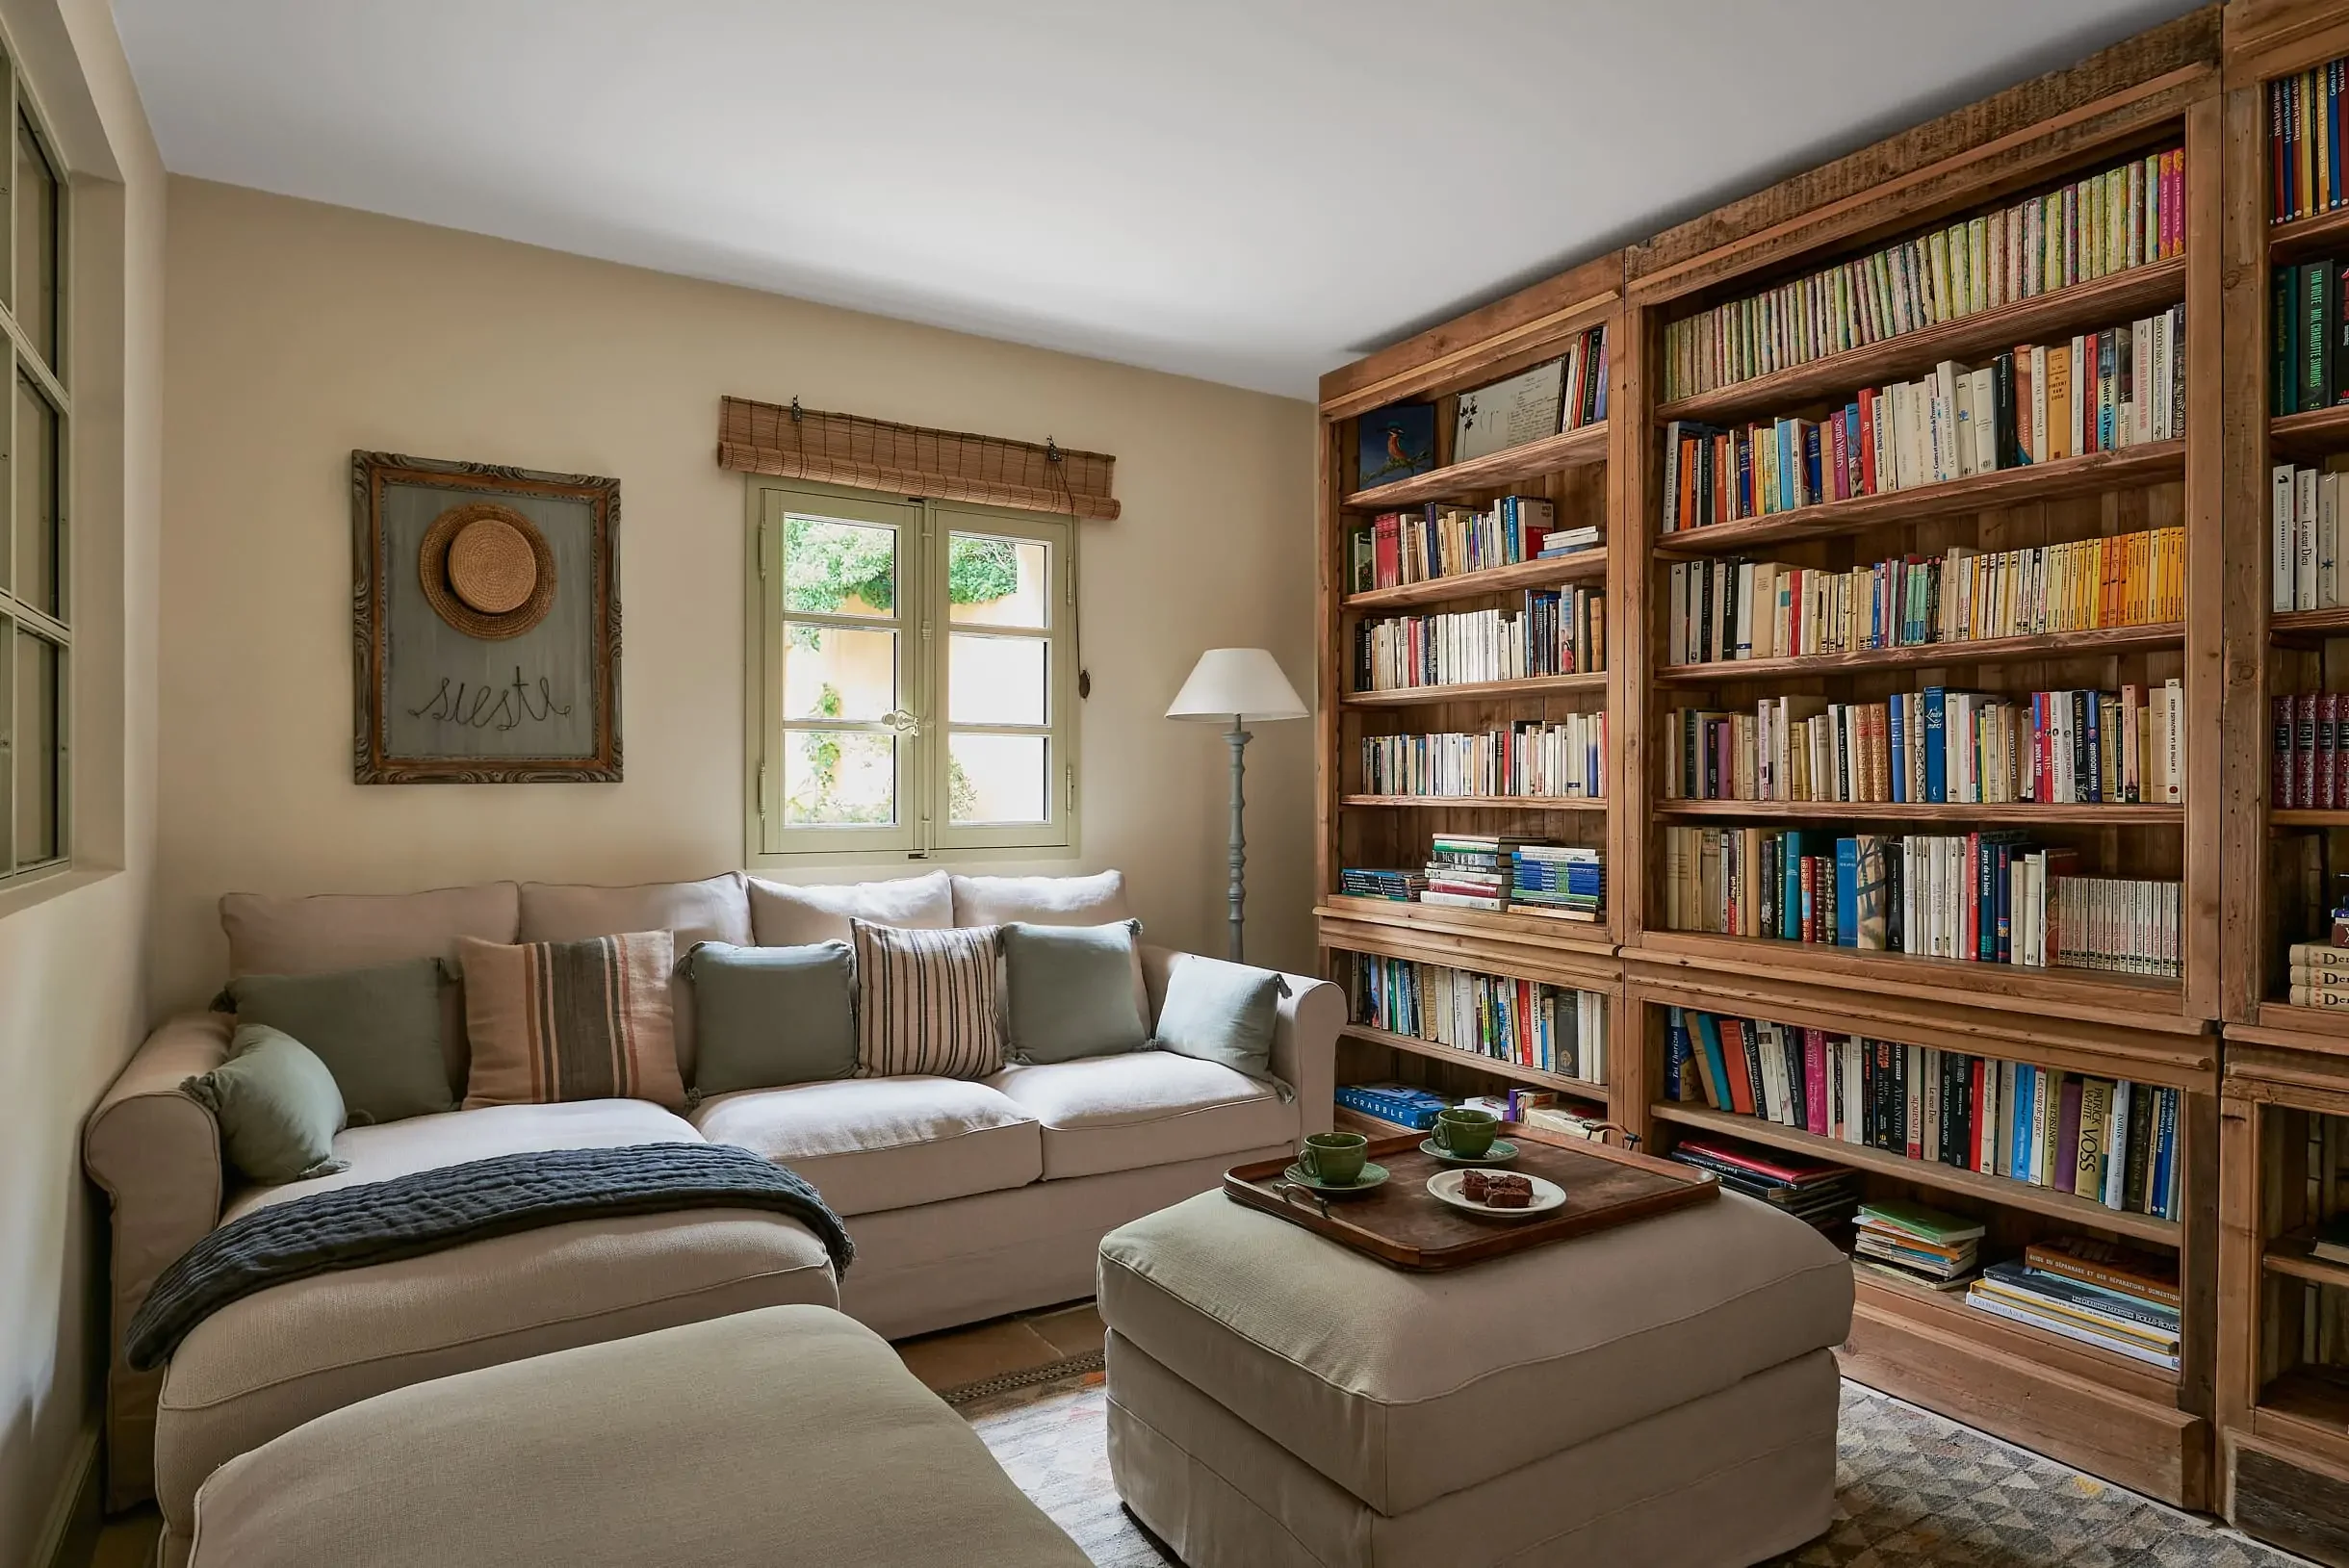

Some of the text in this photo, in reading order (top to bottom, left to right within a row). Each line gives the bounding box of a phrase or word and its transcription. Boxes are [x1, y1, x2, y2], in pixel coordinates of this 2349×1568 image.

[2310, 269, 2322, 304] TOM WOLFE
[2310, 323, 2322, 358] CHARLOTTE
[2103, 373, 2112, 401] Histoire
[2310, 359, 2322, 387] SIMMONS
[2103, 403, 2111, 412] de
[1834, 418, 1845, 468] Sarah Waters
[2302, 520, 2311, 566] Le sieur Dieu
[1983, 865, 1990, 874] de
[1345, 1095, 1404, 1118] SCRABBLE
[1894, 1086, 1903, 1139] ATLANTIDE
[2036, 1078, 2045, 1116] Le coup de
[2083, 1090, 2093, 1119] WHITE
[2091, 1088, 2104, 1125] PATRICK
[1910, 1095, 1919, 1139] La revanche
[2079, 1128, 2098, 1172] VOSS
